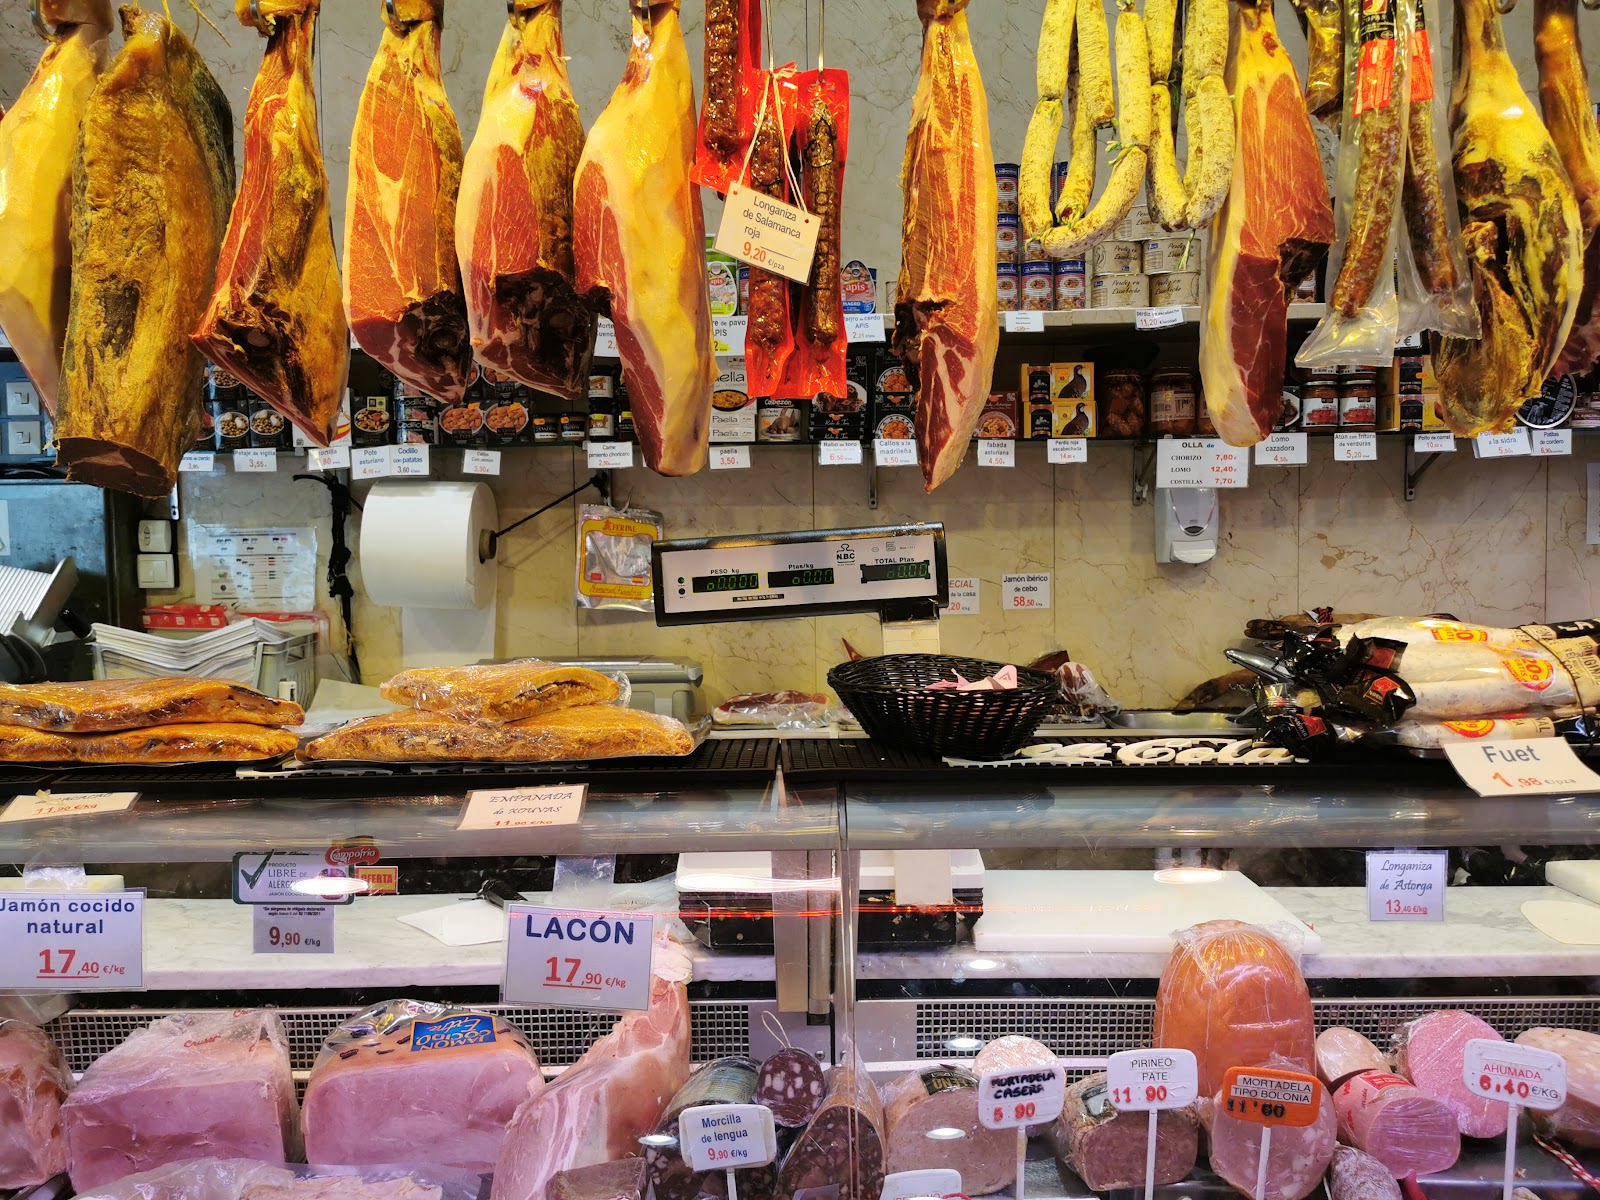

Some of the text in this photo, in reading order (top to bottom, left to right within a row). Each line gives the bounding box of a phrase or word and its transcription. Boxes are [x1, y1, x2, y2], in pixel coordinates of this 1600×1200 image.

[753, 195, 797, 222] Longaniza
[742, 207, 801, 239] de Salamanca
[744, 224, 760, 239] roja
[742, 241, 766, 263] 9,20
[845, 282, 866, 292] apis
[729, 319, 746, 327] pavo
[1140, 319, 1158, 327] 11,20
[1403, 335, 1412, 346] €
[712, 415, 738, 424] Paella
[1270, 435, 1290, 443] Lomo
[1358, 432, 1376, 440] fritura
[1500, 436, 1517, 444] sidra
[1181, 441, 1204, 449] OLLA
[1265, 444, 1295, 452] cazadora
[363, 449, 378, 457] Pote
[397, 447, 419, 455] Codillo
[720, 448, 738, 456] paella
[879, 447, 912, 455] madrileña
[1346, 449, 1362, 459] 5,20
[359, 457, 385, 465] asturiano
[720, 457, 736, 466] 3,50
[829, 453, 844, 461] 6,50
[988, 457, 1004, 465] 4,50
[1215, 453, 1233, 462] 7,80
[248, 459, 265, 469] 3,55
[397, 466, 410, 474] 3,60
[1210, 466, 1233, 474] 12,40
[1215, 477, 1233, 486] 7,70
[611, 524, 637, 533] FERPAL
[788, 562, 814, 570] Ptas/kg
[874, 556, 915, 565] TOTAL Ptas
[710, 567, 740, 576] PESO kg
[1003, 574, 1048, 583] Jamón ibérico
[1013, 595, 1035, 607] 58,50
[1481, 744, 1541, 763] Fuet
[1491, 771, 1543, 789] 1,98
[489, 792, 574, 804] EMPANADA
[268, 869, 297, 878] LIBRE
[1380, 859, 1433, 877] Longaniza
[361, 873, 393, 885] OFERTA
[1379, 879, 1434, 897] de Astorga
[0, 898, 136, 913] Jamón cocido
[1385, 899, 1412, 914] 13,40
[27, 919, 104, 934] natural
[526, 912, 635, 945] LACÓN
[269, 926, 321, 948] 9,90 €/kg
[38, 948, 126, 976] 17,40 €/kg
[545, 956, 627, 989] 17,90 €/kg
[425, 1017, 482, 1034] Extra
[415, 1029, 492, 1046] COCIDO
[1130, 1057, 1174, 1069] PIRINEO
[1141, 1072, 1169, 1082] PATE
[1483, 1063, 1542, 1081] AHUMADA
[991, 1071, 1056, 1087] MORTADELA
[1242, 1077, 1312, 1093] MORTADELA
[994, 1084, 1045, 1099] CASERA
[1145, 1085, 1168, 1102] 90
[1232, 1086, 1310, 1103] TIPO BOLONIA
[1531, 1085, 1560, 1099] €/KG
[701, 1114, 742, 1130] Morcilla
[701, 1128, 749, 1144] de lengua
[707, 1147, 749, 1161] 9,90 €/kg
